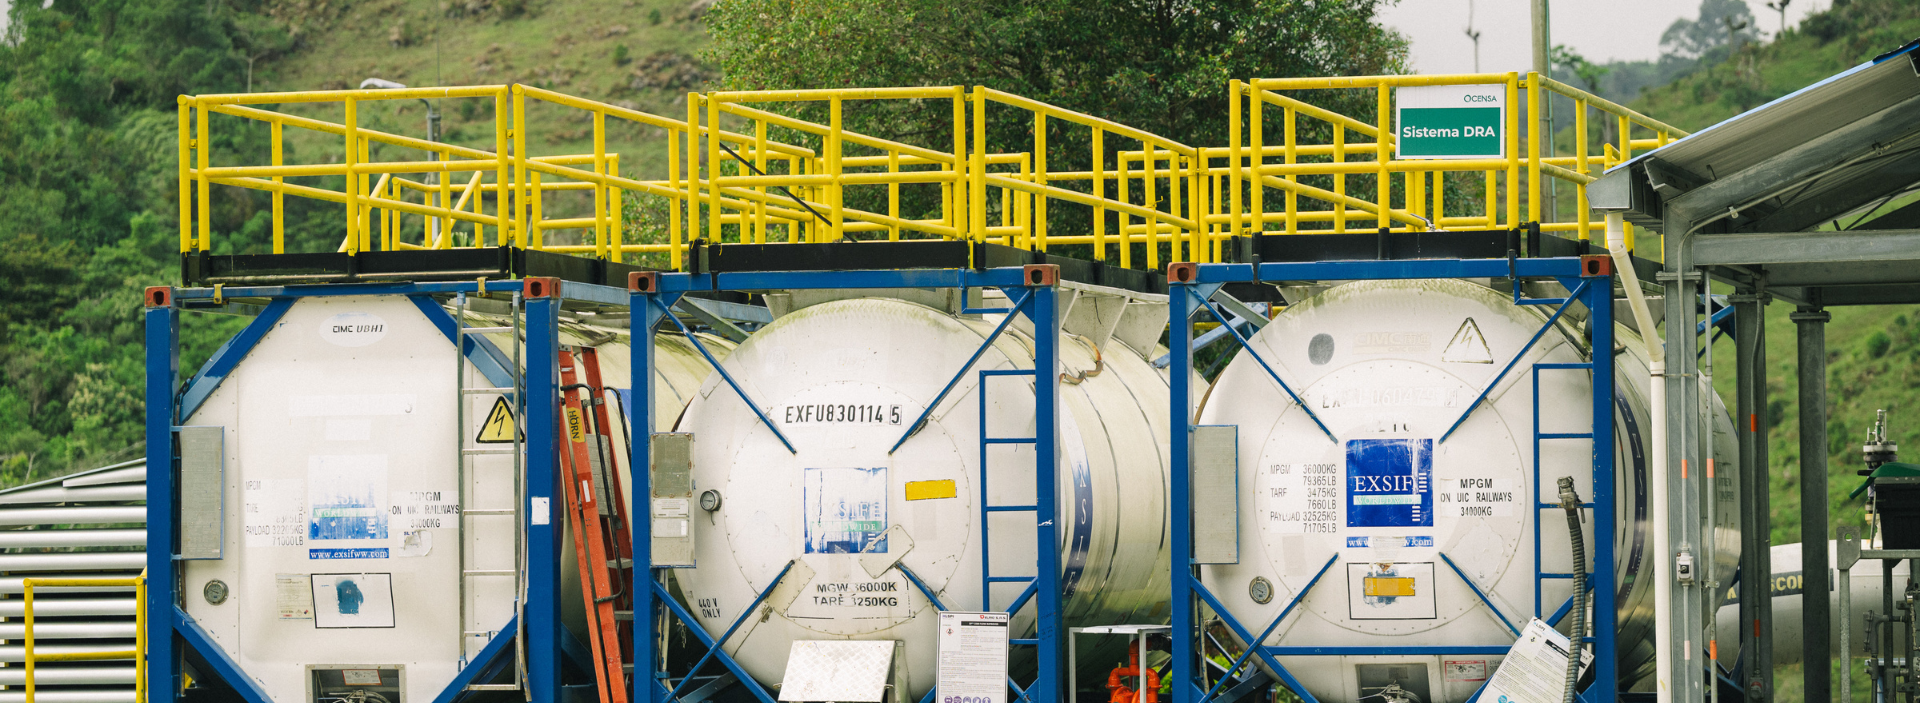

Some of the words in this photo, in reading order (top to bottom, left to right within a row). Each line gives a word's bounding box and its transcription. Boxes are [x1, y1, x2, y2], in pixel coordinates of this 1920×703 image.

[1463, 94, 1498, 103] OCENSA
[1402, 125, 1460, 138] Sistema
[1463, 125, 1496, 137] DRA
[785, 404, 883, 423] EXFU830114
[891, 406, 900, 424] 5
[1302, 463, 1337, 474] 36000KG
[1302, 475, 1337, 486] 79365LB
[1353, 475, 1415, 492] EXSIF
[1460, 478, 1493, 489] MPGM
[1307, 487, 1337, 498] 3475KG
[1440, 492, 1451, 503] ON
[1456, 492, 1470, 502] UIC
[1475, 491, 1513, 503] RAILWAYS
[1307, 499, 1337, 509] 7660LB
[391, 505, 402, 515] ON
[1460, 506, 1492, 516] 34000KG
[1302, 511, 1337, 521] 32525KG
[1302, 522, 1337, 533] 71705LB
[310, 549, 388, 559] www.exsifww.com
